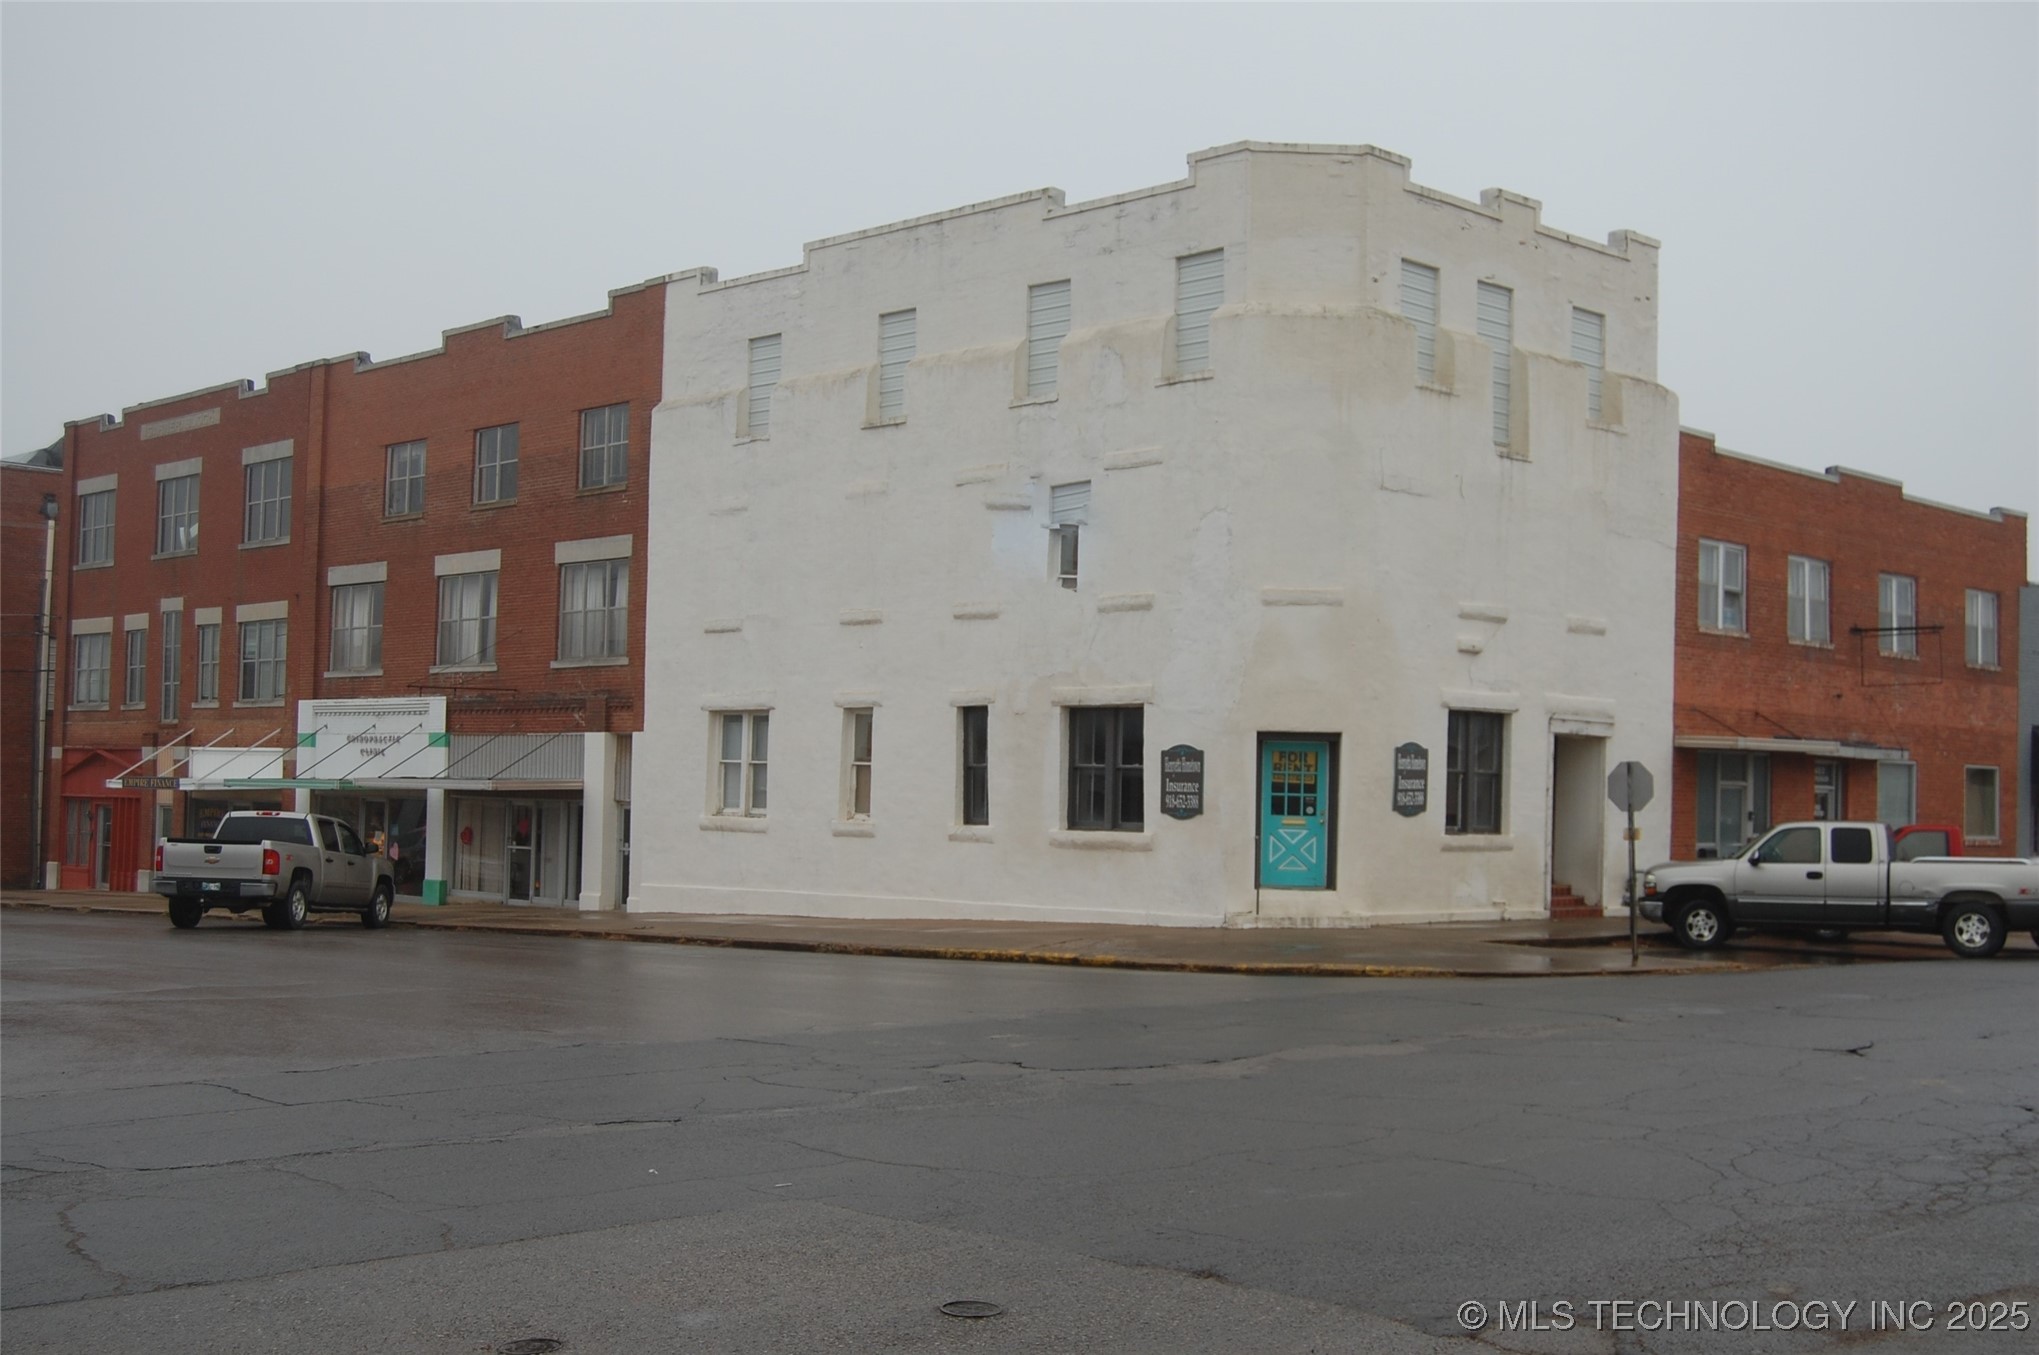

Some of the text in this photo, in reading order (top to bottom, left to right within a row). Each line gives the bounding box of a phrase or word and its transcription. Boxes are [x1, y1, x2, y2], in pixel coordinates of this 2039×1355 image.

[1279, 751, 1308, 762] FOR
[124, 777, 177, 788] EMPIRE FINANCE
[1166, 778, 1199, 792] Insurance
